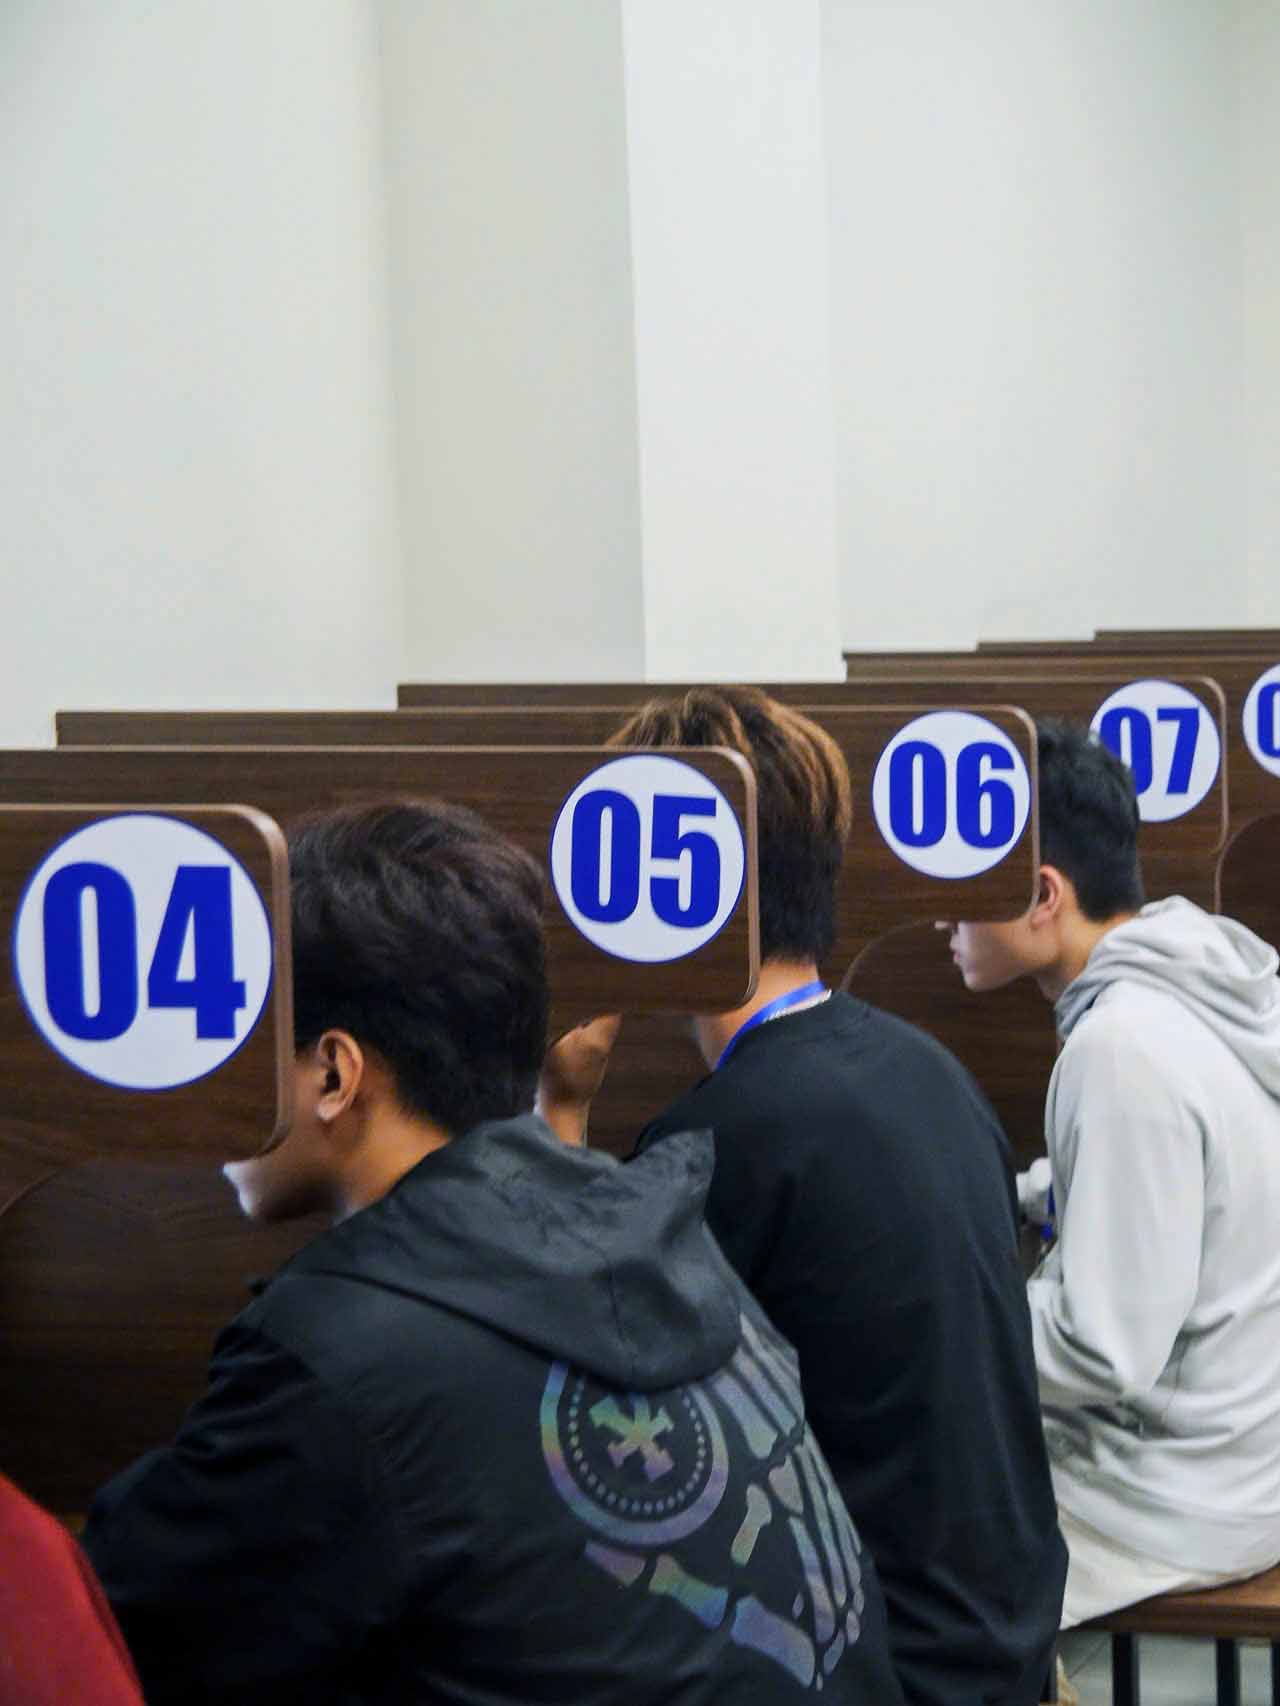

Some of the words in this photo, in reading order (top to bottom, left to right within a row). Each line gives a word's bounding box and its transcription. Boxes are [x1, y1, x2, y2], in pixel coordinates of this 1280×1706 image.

[889, 740, 1016, 850] 06
[1099, 706, 1201, 797] 07
[570, 789, 722, 929] 05
[42, 861, 247, 1042] 04
